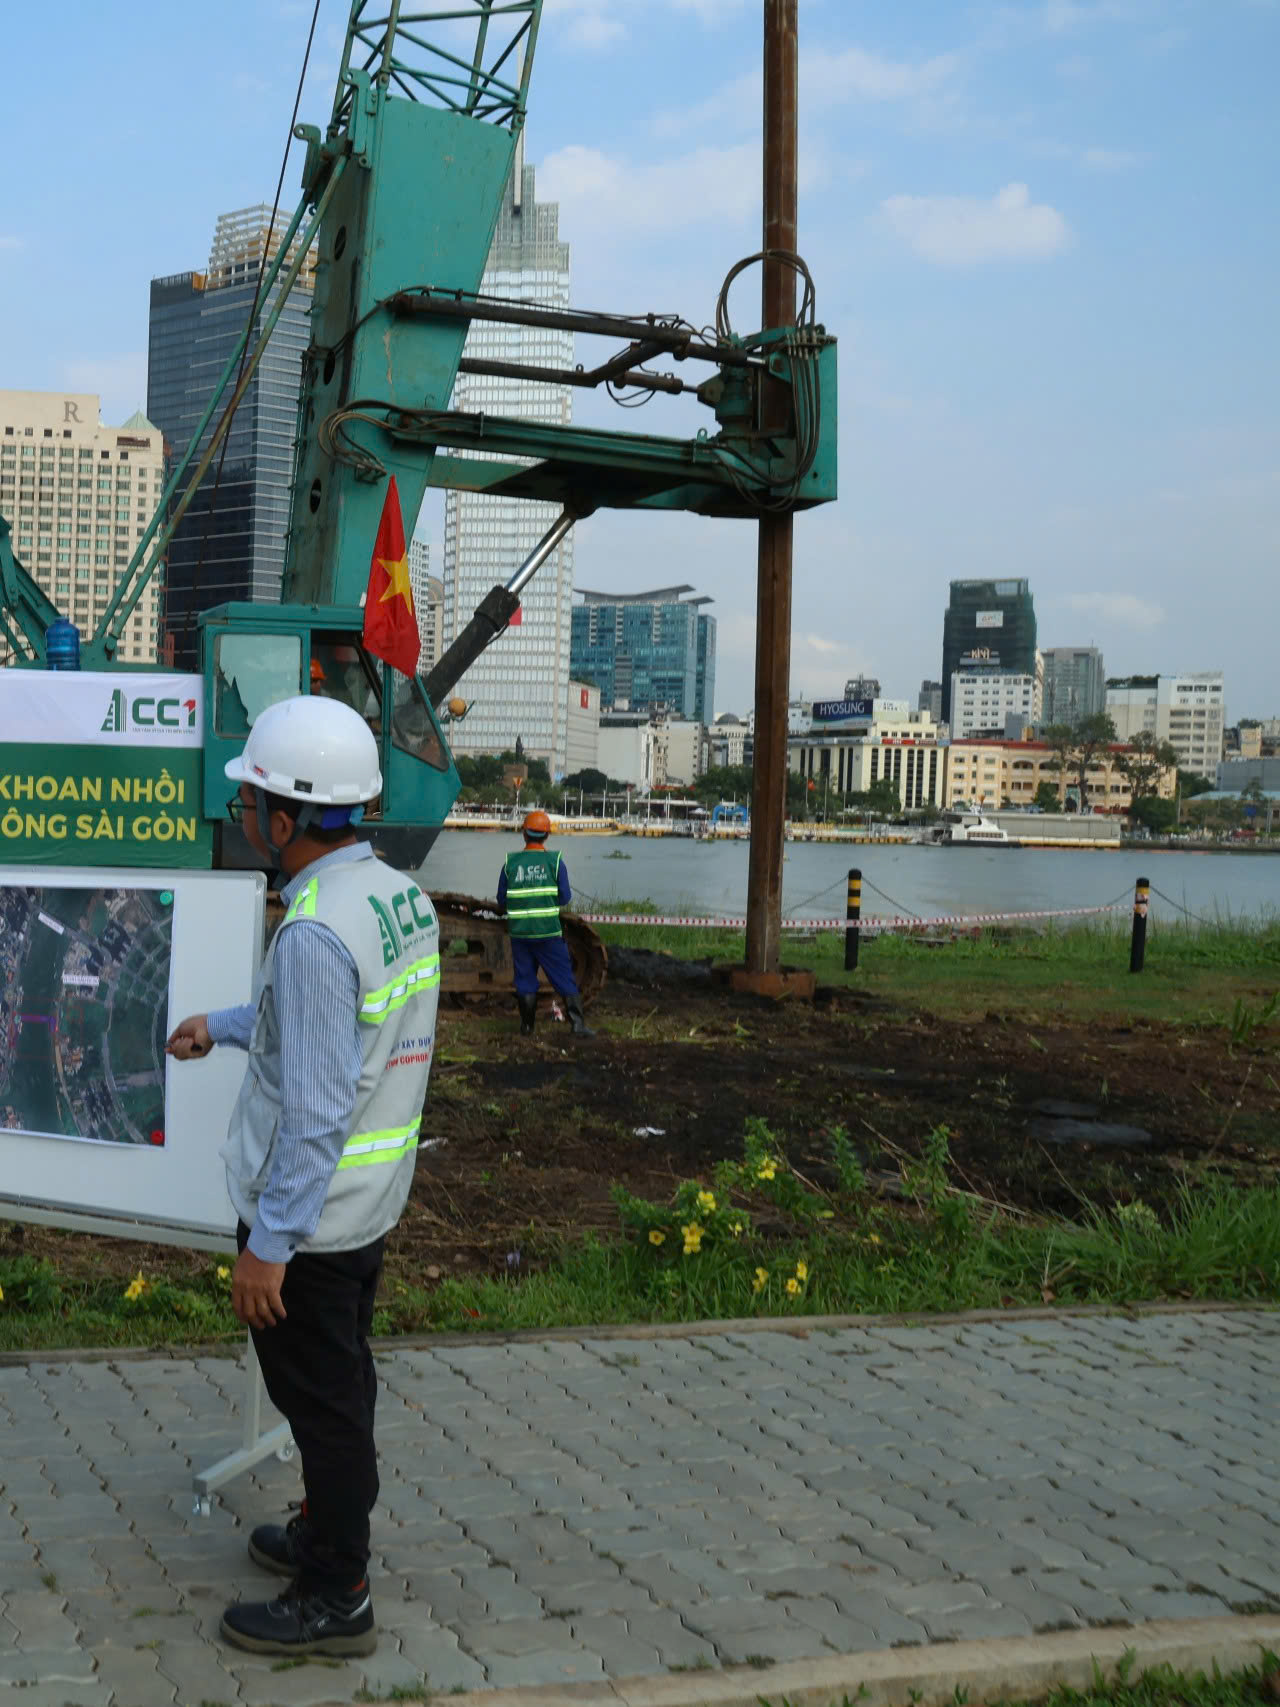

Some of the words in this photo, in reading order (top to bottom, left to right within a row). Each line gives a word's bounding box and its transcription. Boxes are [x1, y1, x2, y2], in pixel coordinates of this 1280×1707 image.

[63, 401, 83, 423] R
[131, 697, 196, 727] CC1
[820, 702, 865, 715] HYOSUNG
[110, 768, 185, 804] NHỒI
[75, 808, 124, 840] SÀI
[131, 809, 196, 841] GÒN
